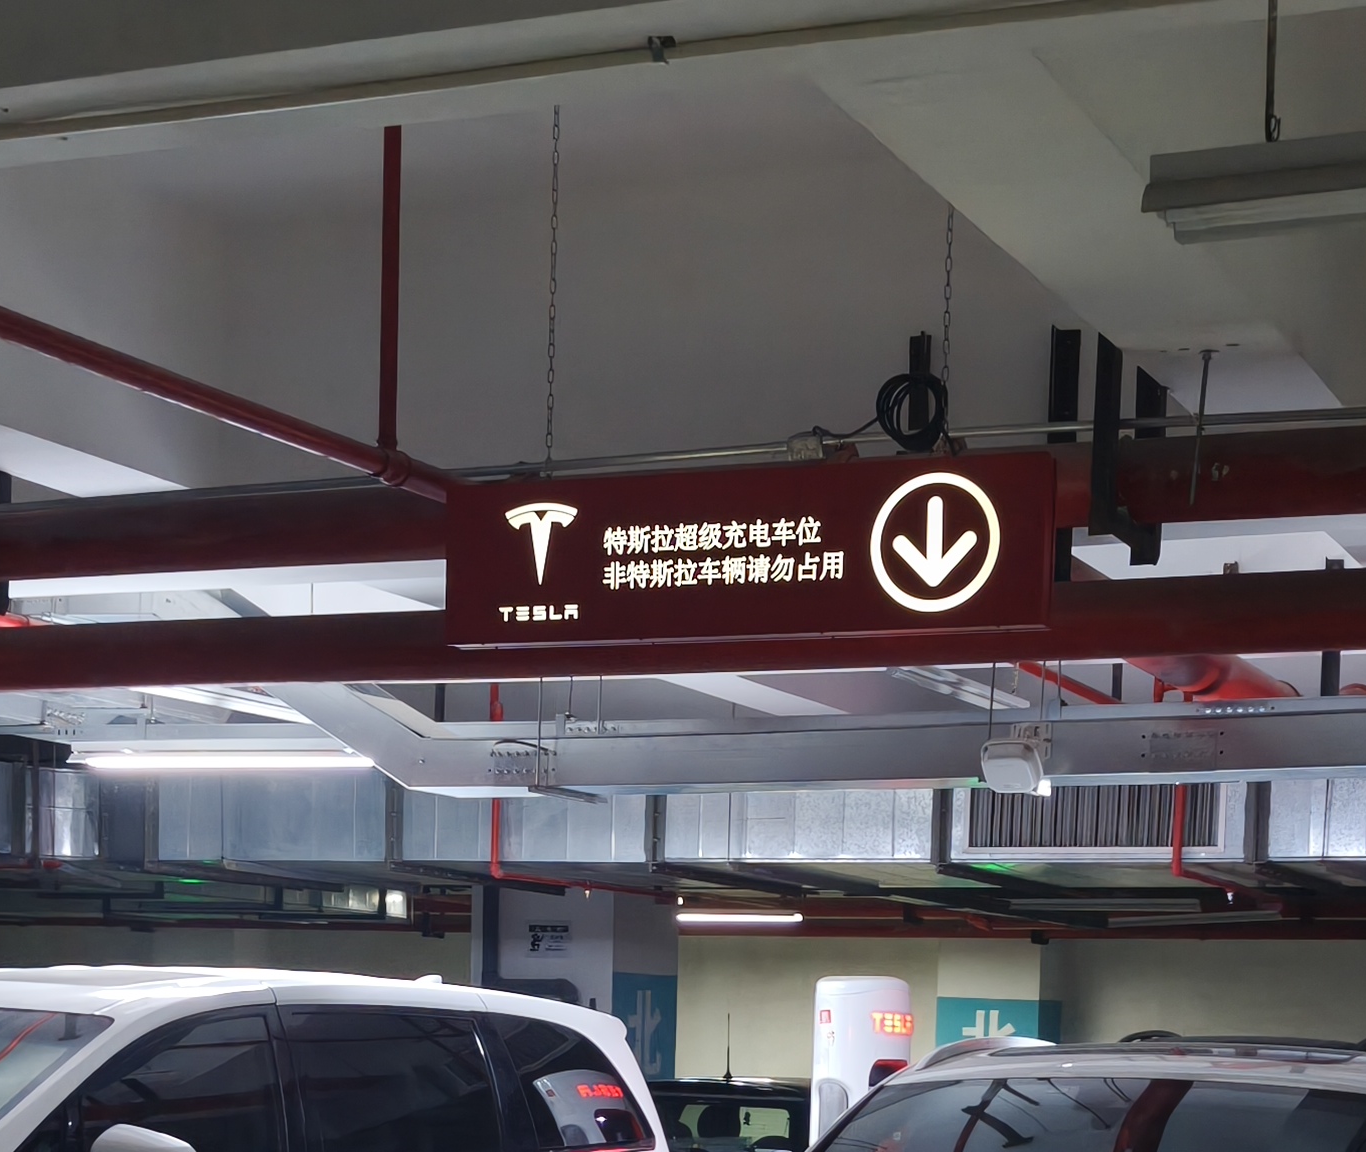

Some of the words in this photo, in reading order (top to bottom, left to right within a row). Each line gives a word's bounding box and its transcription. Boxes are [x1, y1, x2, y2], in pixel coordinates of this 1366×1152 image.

[603, 516, 822, 553] 特斯拉超级充电车位
[602, 550, 845, 591] 非特斯拉车辆请勿占用
[498, 604, 579, 622] TESLA
